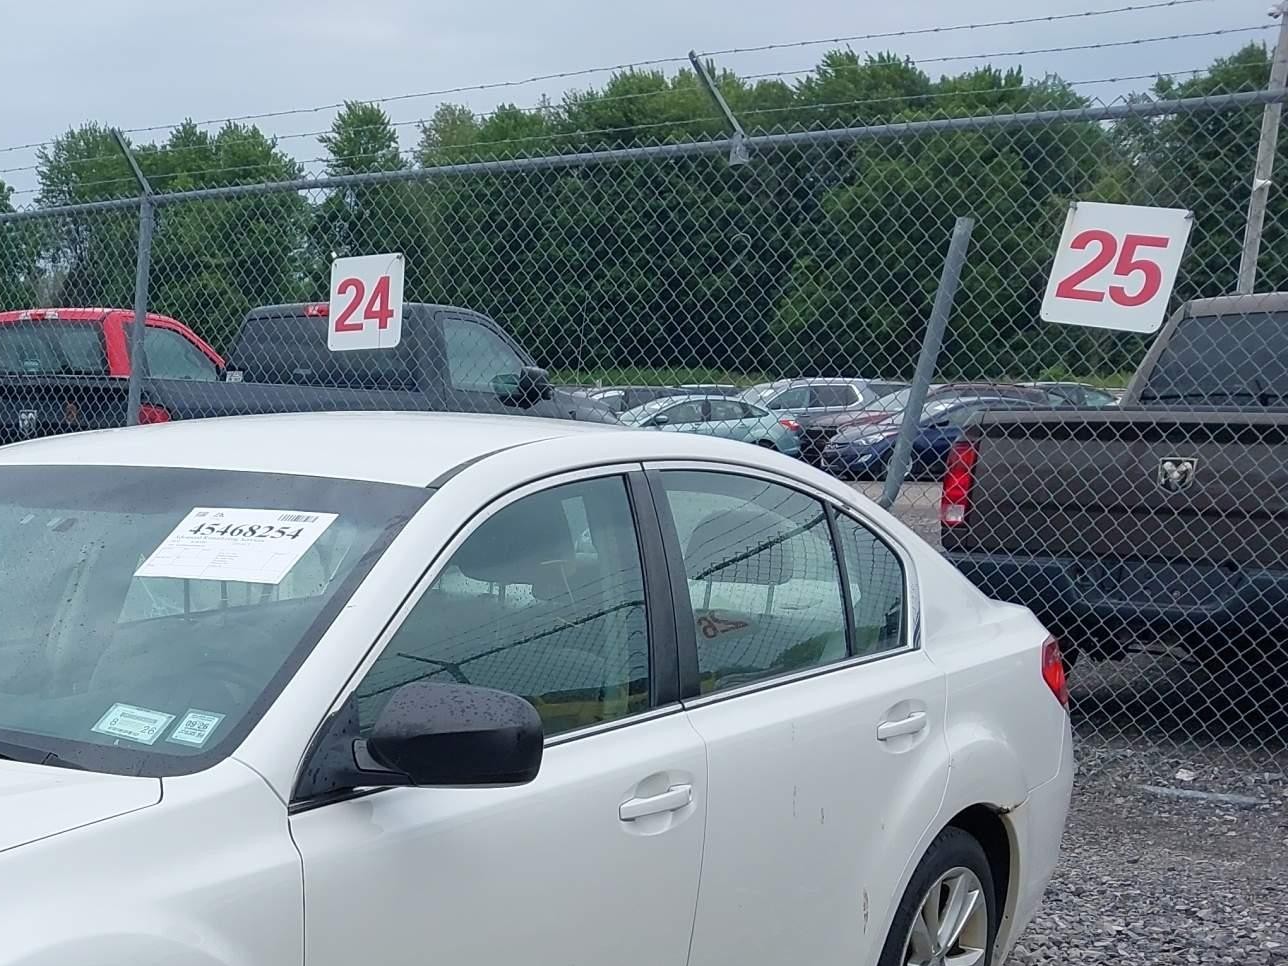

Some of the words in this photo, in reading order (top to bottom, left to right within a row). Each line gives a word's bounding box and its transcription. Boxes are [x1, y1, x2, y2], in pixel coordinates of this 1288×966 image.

[1055, 229, 1169, 307] 25
[334, 275, 394, 332] 24
[189, 522, 304, 541] 45468254
